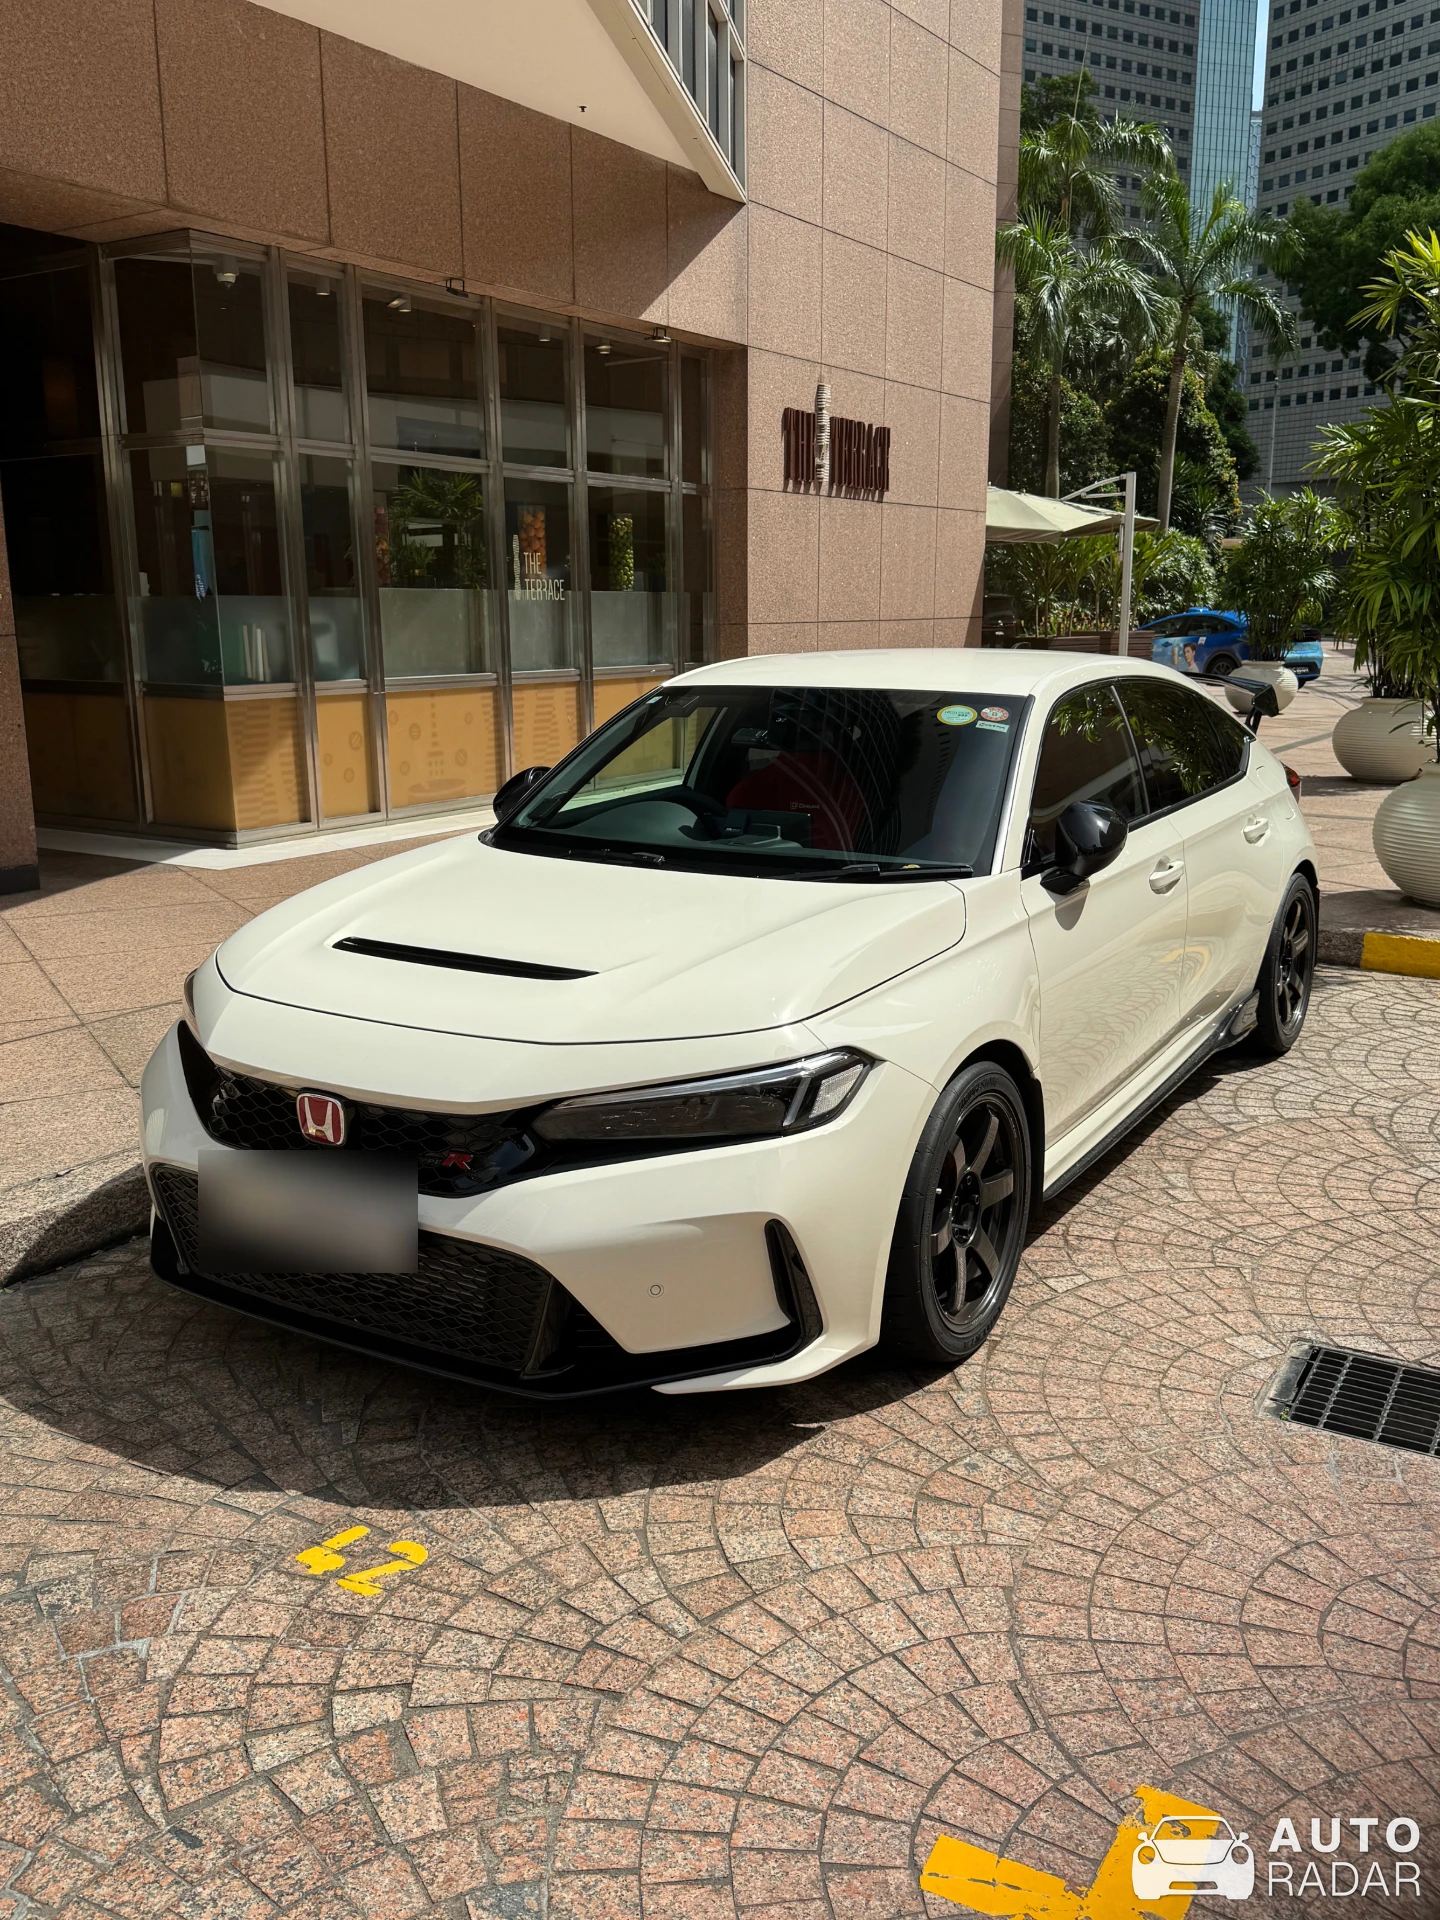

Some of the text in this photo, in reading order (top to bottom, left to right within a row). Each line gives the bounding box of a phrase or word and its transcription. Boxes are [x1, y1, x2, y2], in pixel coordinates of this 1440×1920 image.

[781, 407, 891, 492] THE TERRACE
[523, 552, 542, 575] THE
[524, 579, 566, 601] TERRACE
[441, 1152, 474, 1170] R
